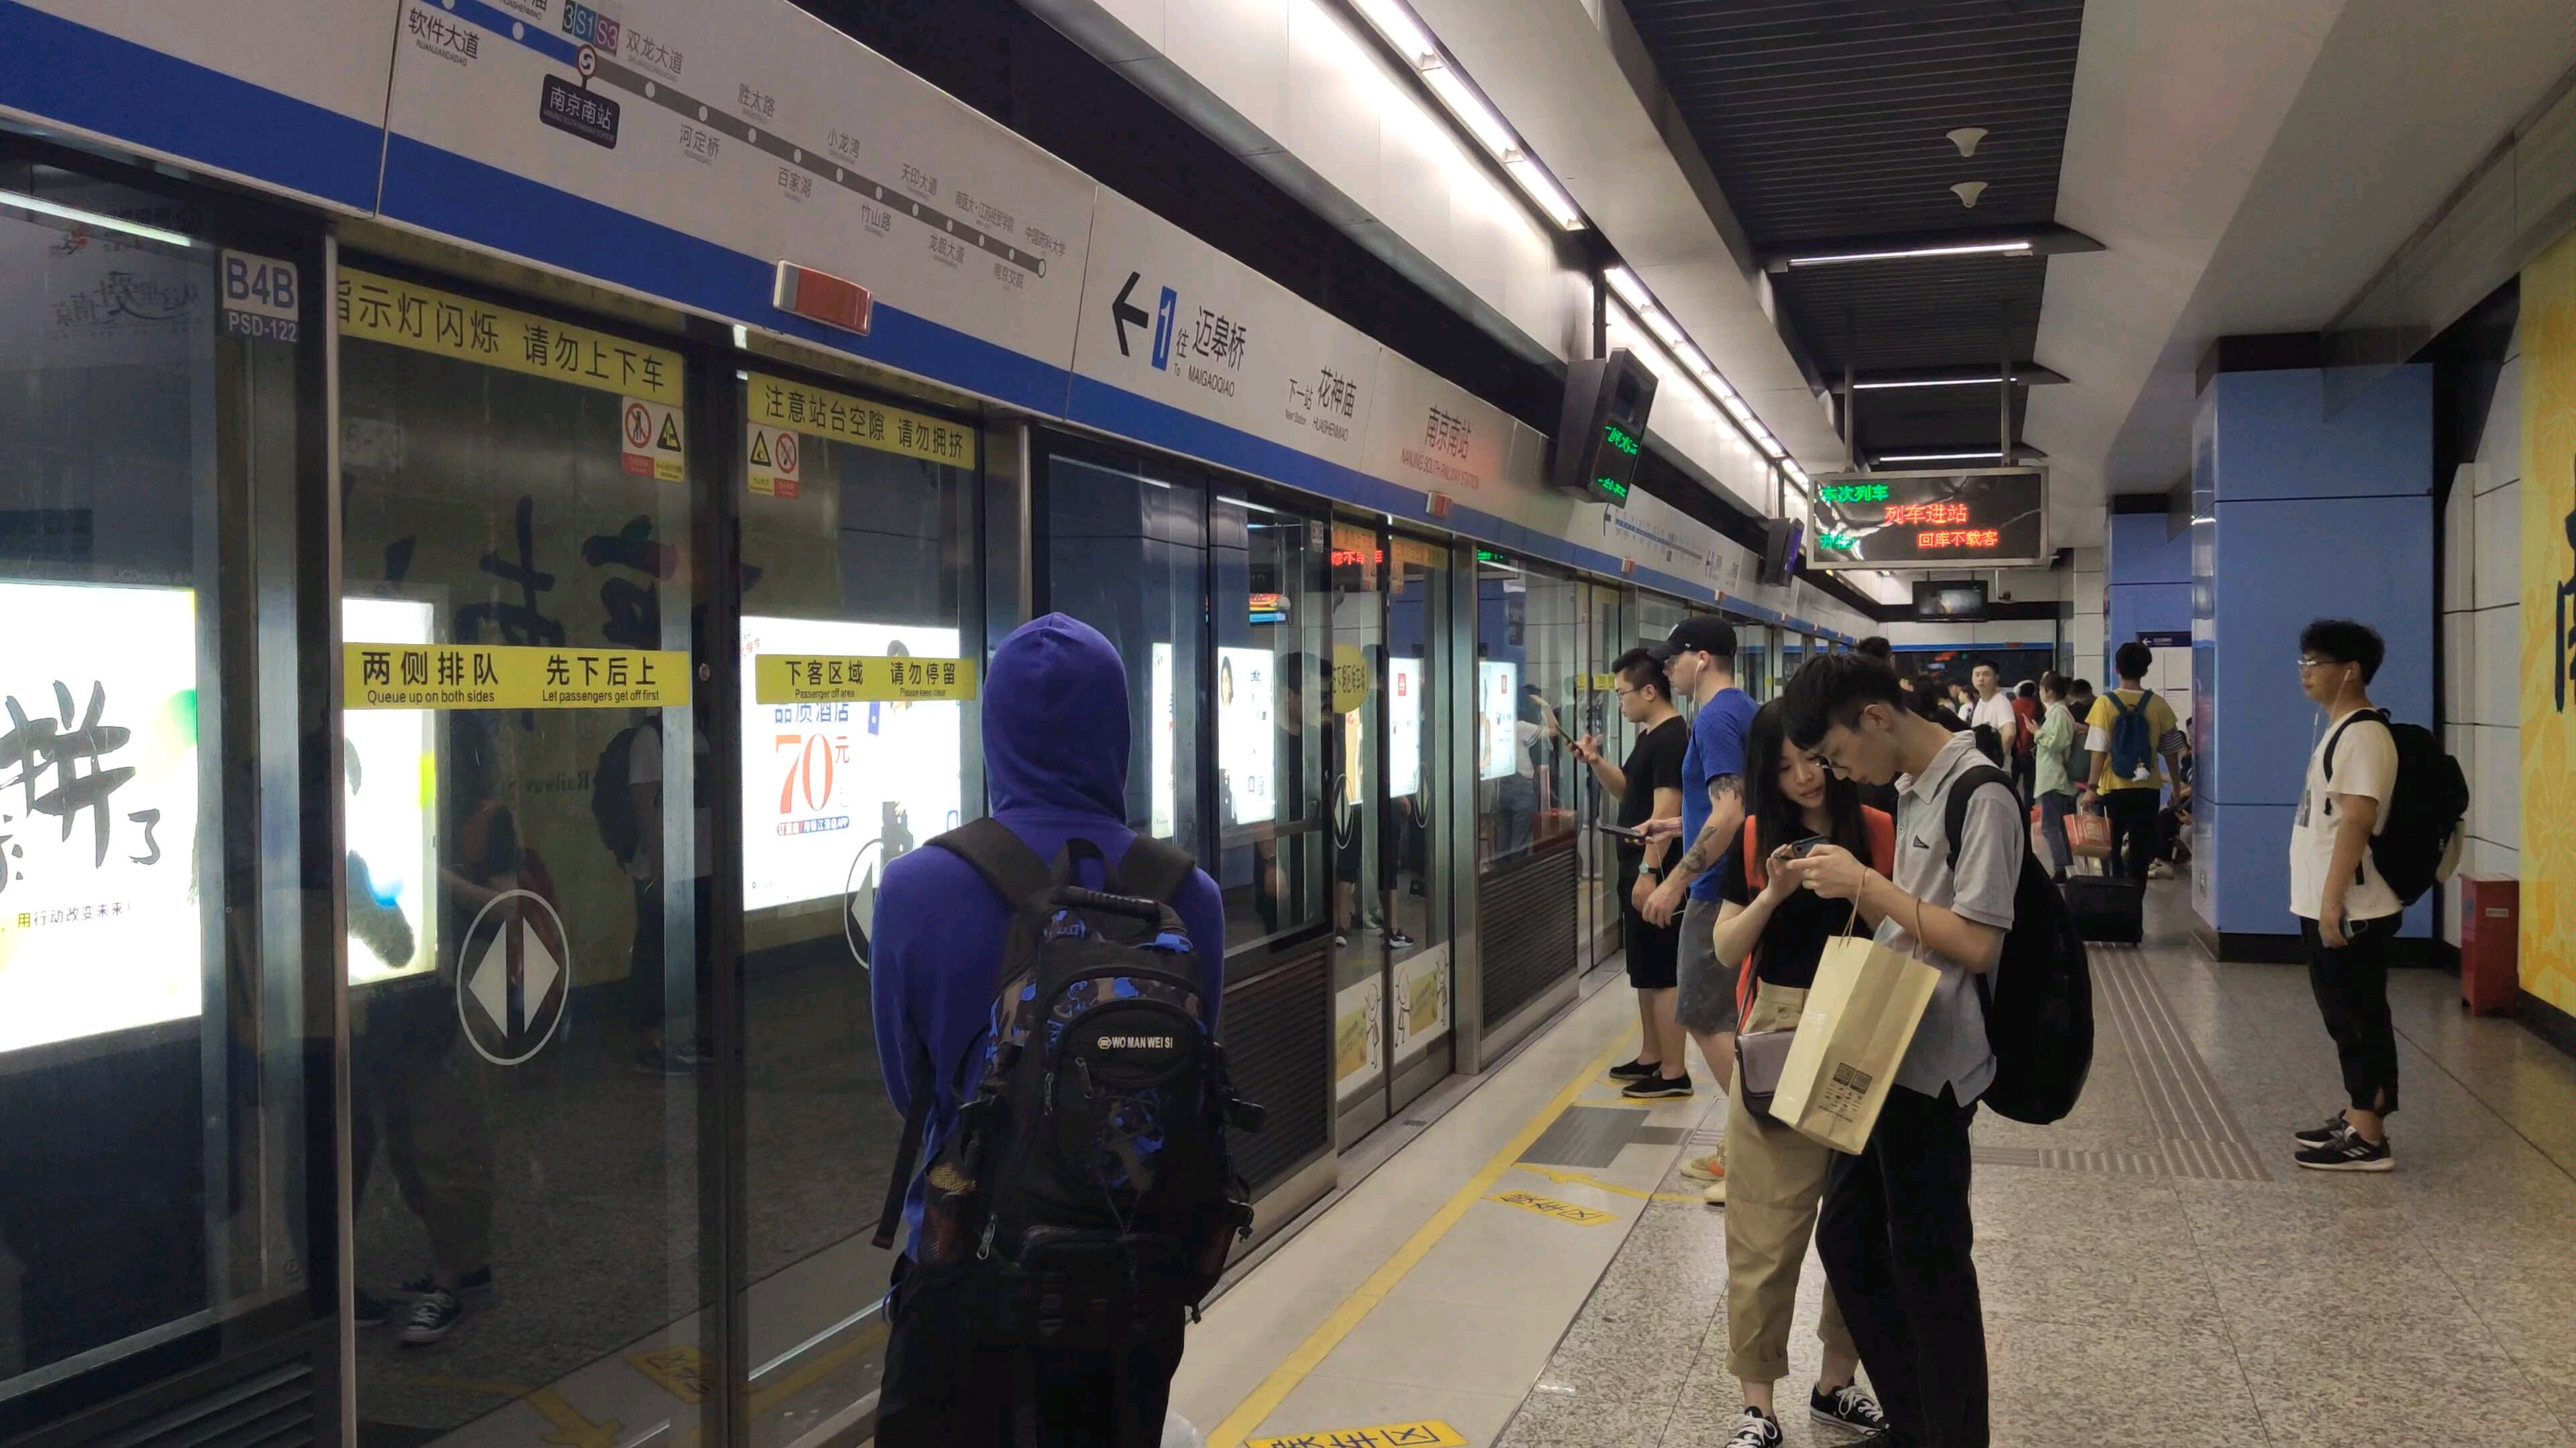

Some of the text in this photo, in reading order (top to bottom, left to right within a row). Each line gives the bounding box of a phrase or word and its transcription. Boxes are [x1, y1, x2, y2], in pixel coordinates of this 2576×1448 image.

[408, 7, 480, 59] 软件大道
[564, 4, 574, 30] 3
[576, 10, 593, 38] S1
[596, 19, 617, 50] S3
[626, 29, 684, 74] 双龙大道
[549, 86, 612, 131] 南京南站
[738, 83, 775, 117] 胜太路
[679, 123, 720, 159] 河定桥
[827, 127, 860, 158] 小龙湾
[778, 166, 812, 198] 百家湖
[860, 203, 892, 232] 竹山路
[226, 256, 296, 309] B4B
[228, 312, 298, 342] PSD-122
[1160, 299, 1173, 359] 1
[1176, 305, 1247, 372] 往 迈皋桥
[522, 324, 665, 393] 请勿上下车
[1173, 362, 1236, 397] To MAIGAOQIAO
[1289, 365, 1357, 419] 下一站 花神庙
[765, 384, 963, 460] 注意站台空隙 请勿拥挤
[1424, 405, 1472, 461] 南京南站
[1820, 483, 1889, 502] 本次列车
[1884, 503, 1968, 525] 列车进站
[1918, 530, 1999, 548] 回库不载客
[361, 651, 657, 687] 两侧排队 先下后上
[785, 660, 956, 686] 下客区域 请勿停留
[367, 690, 495, 705] Queue up on both sides
[542, 689, 659, 704] Let passengers get off first
[795, 688, 830, 699] Passenger
[840, 690, 855, 698] area
[1111, 1037, 1173, 1048] WO MAN WEI SI
